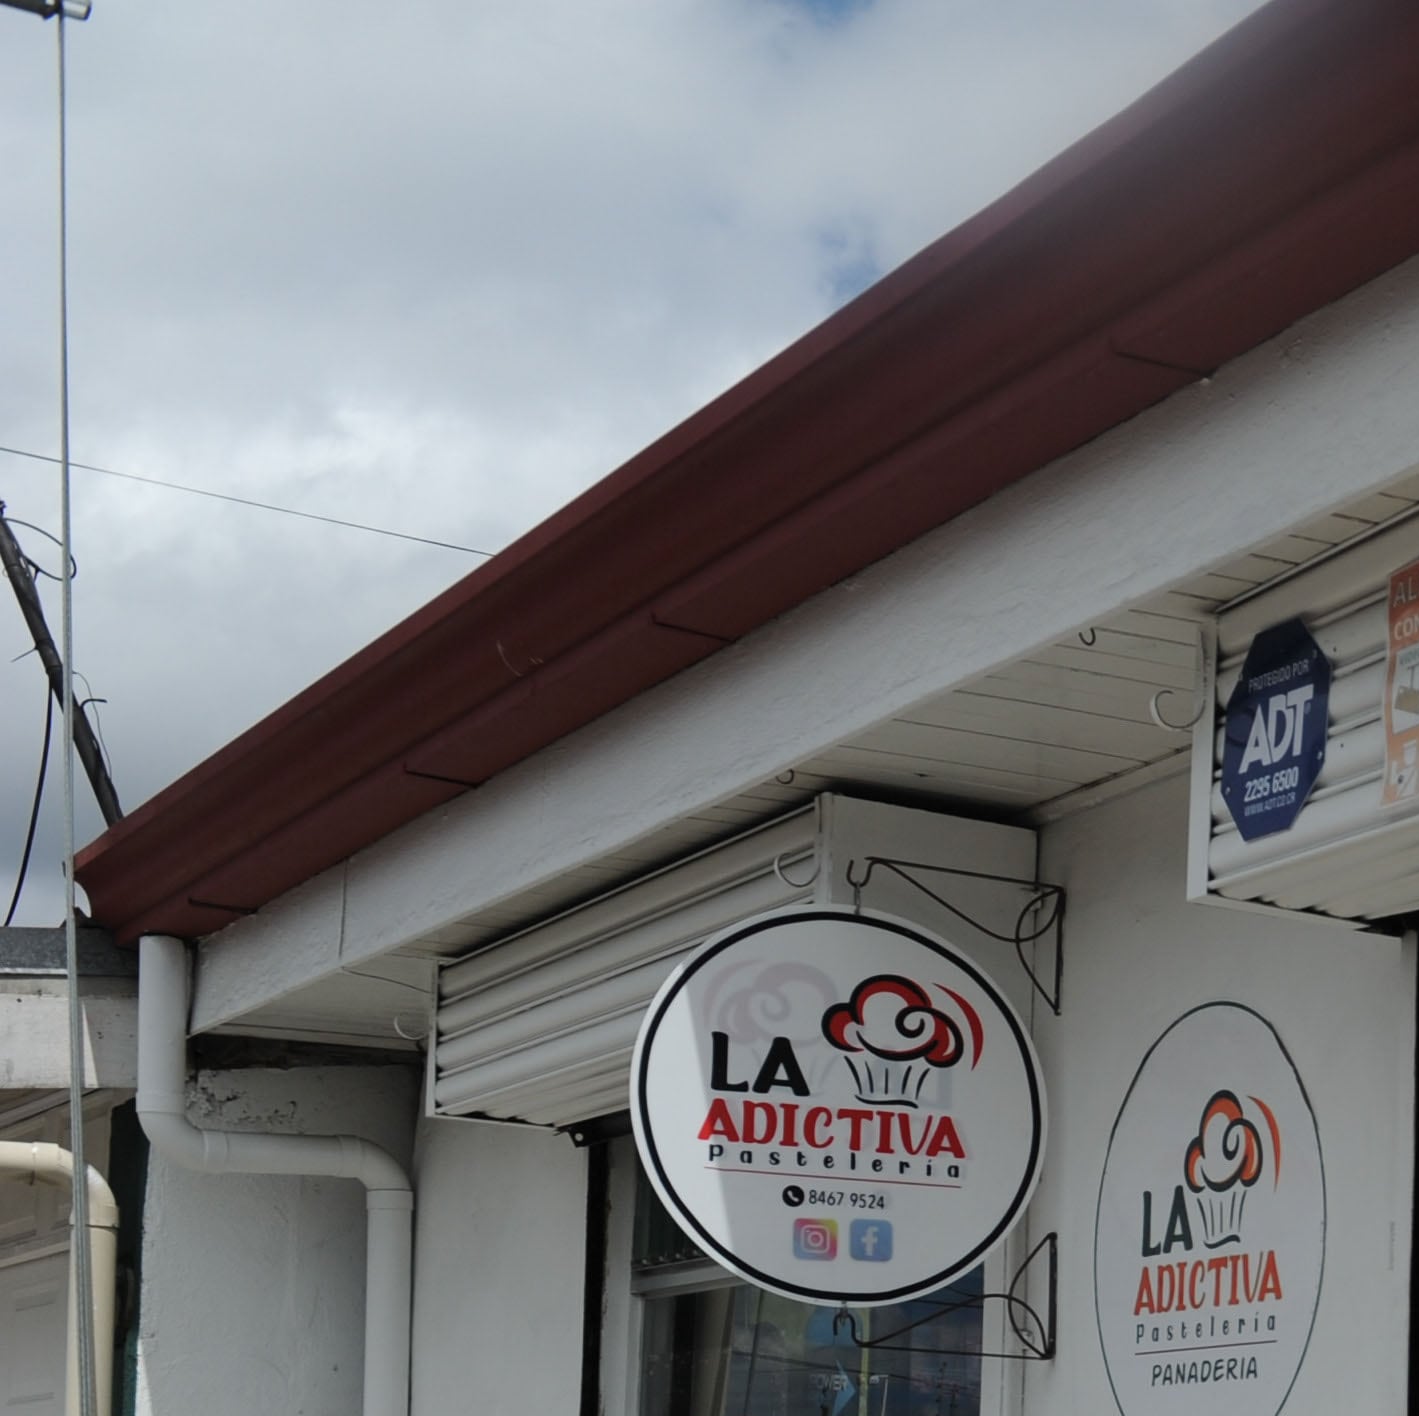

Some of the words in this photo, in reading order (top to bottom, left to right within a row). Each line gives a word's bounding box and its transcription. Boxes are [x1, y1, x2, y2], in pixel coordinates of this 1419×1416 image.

[1248, 664, 1291, 694] PROTEGIDO
[1292, 659, 1310, 677] POR
[1238, 684, 1314, 773] ADT
[1244, 775, 1270, 802] 2295
[1272, 766, 1299, 794] 6500
[711, 1032, 810, 1097] LA
[697, 1098, 966, 1159] ADICTIVA
[808, 1189, 844, 1207] 8467
[850, 1193, 885, 1210] 9524
[1142, 1185, 1193, 1257] LA
[1134, 1250, 1282, 1316] ADICTIVA
[1152, 1356, 1258, 1386] PANADERIA
